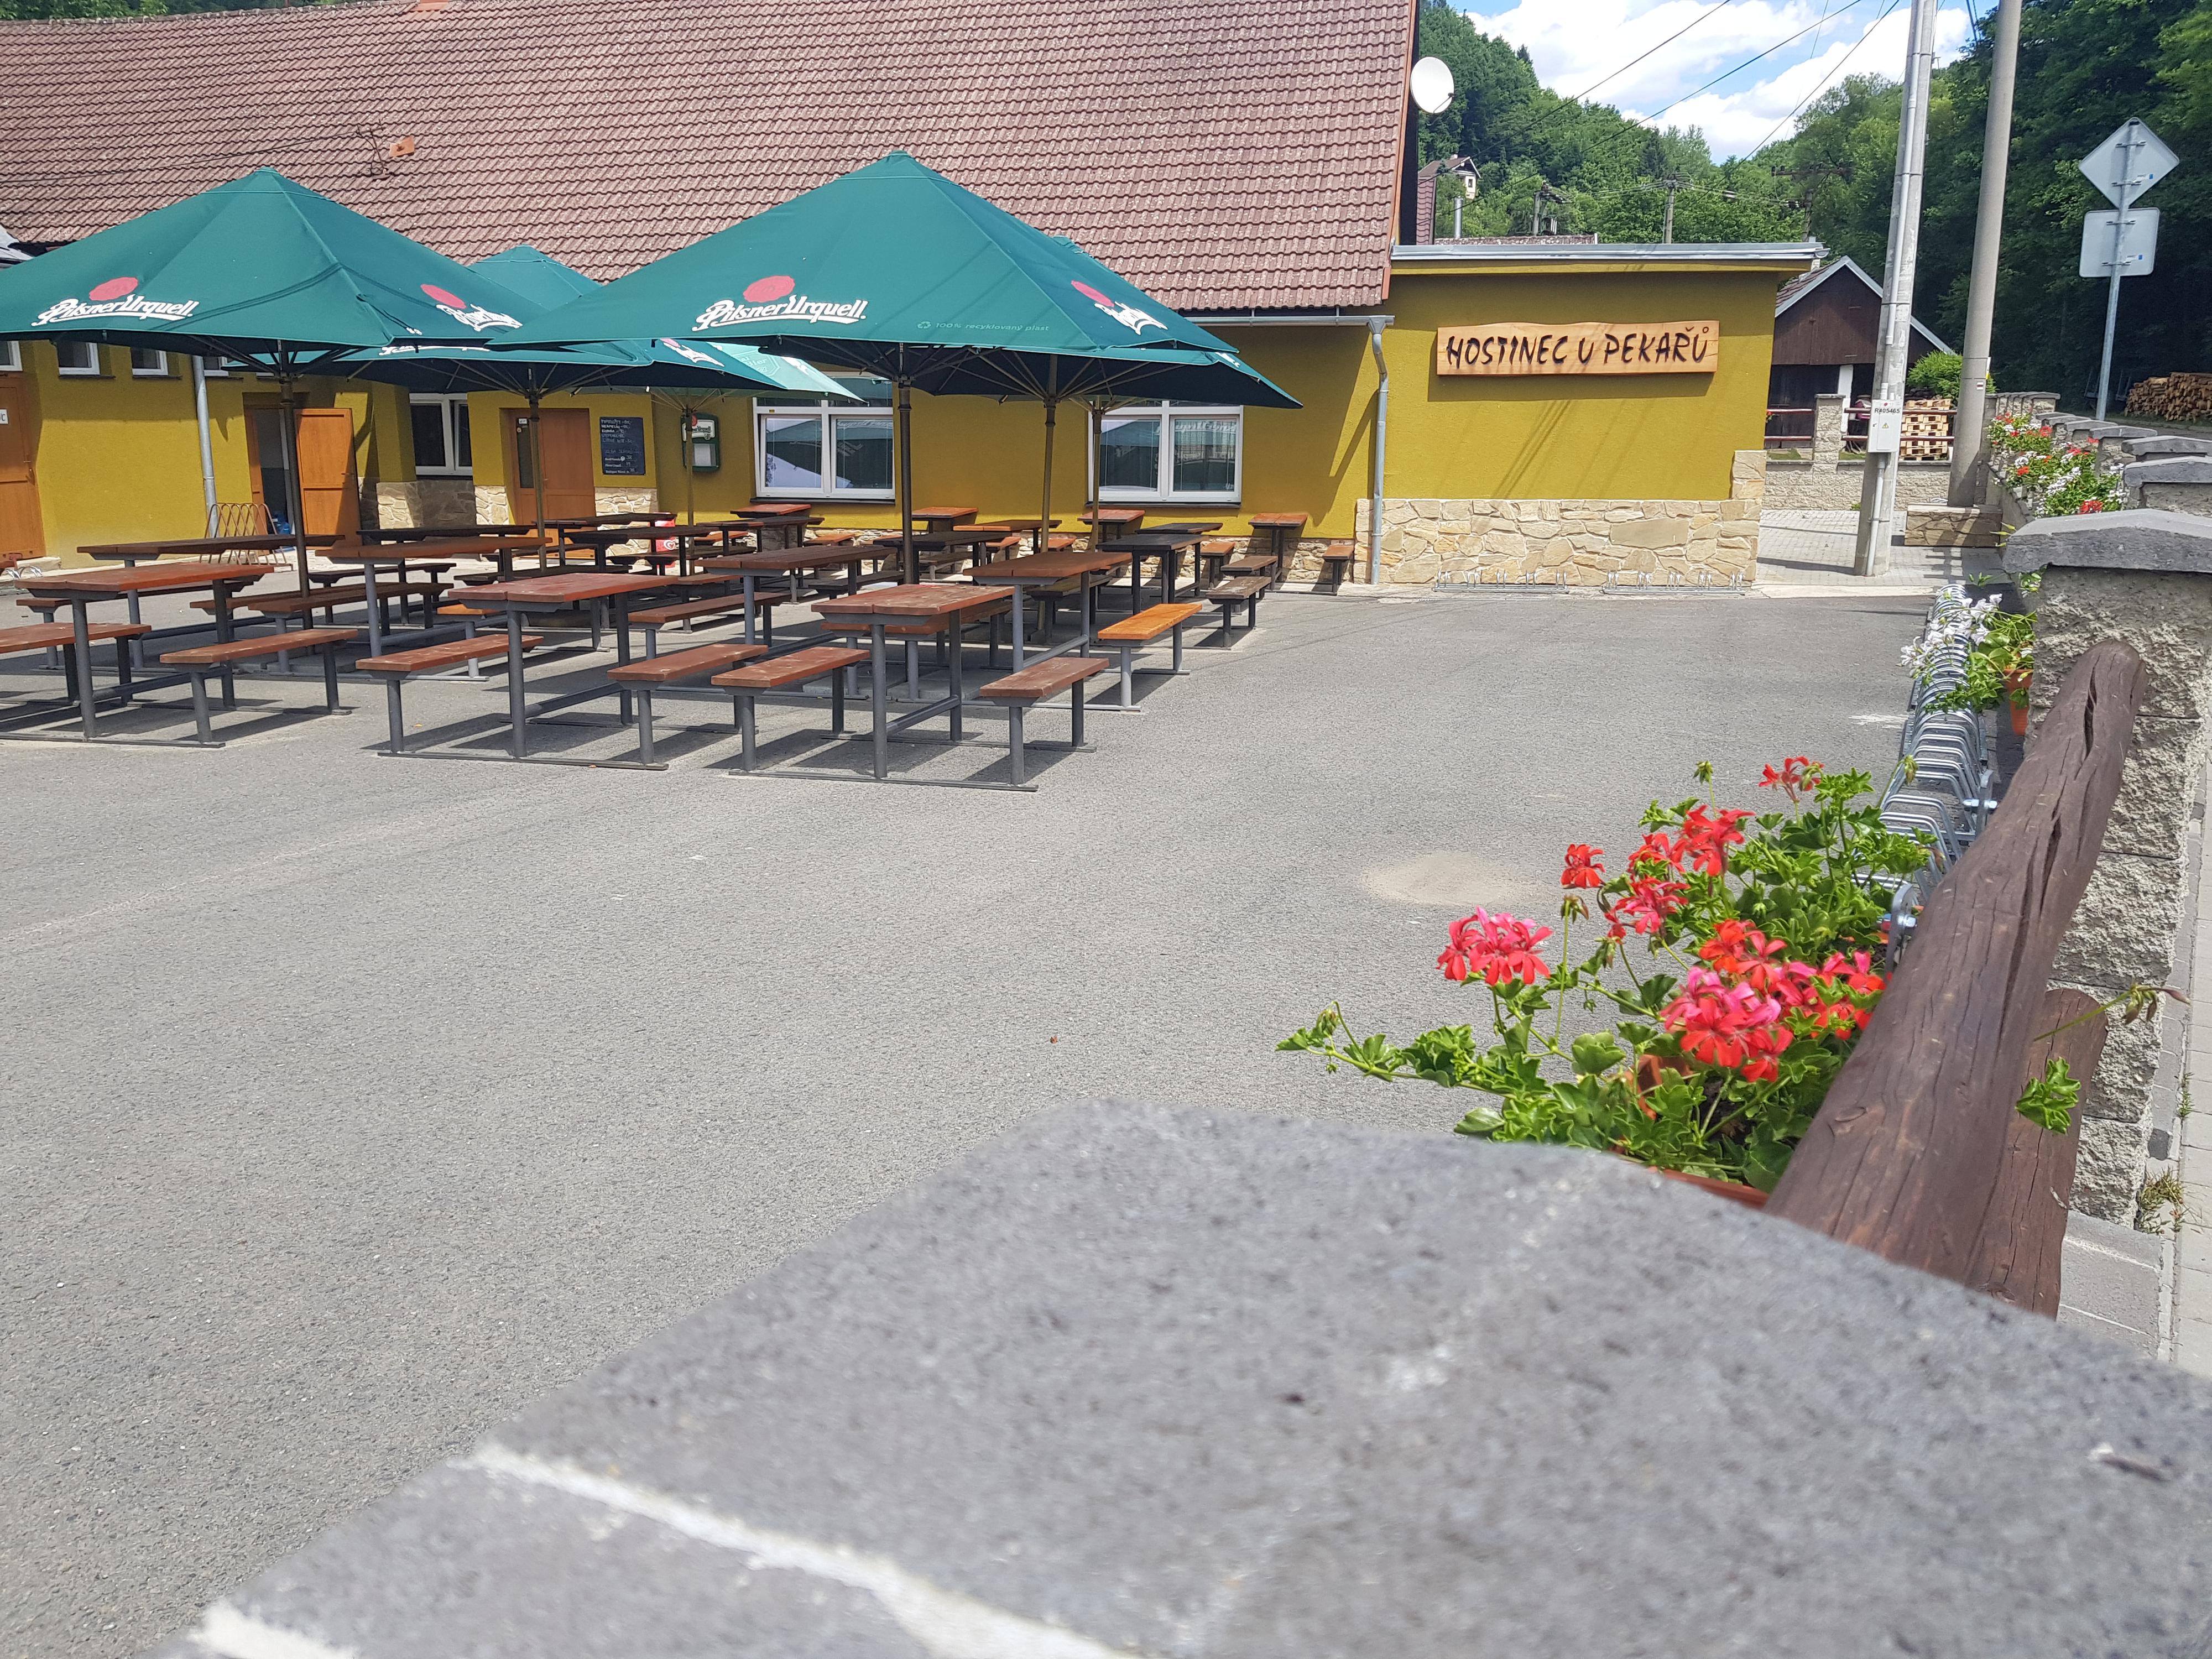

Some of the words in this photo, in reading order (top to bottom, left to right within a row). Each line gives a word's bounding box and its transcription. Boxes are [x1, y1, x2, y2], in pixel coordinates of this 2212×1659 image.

[31, 299, 127, 326] Pilsner
[692, 299, 789, 331] Pilsner
[1446, 334, 1568, 369] HOSTINEC
[1577, 337, 1594, 365] U
[1604, 326, 1709, 364] PEKAŘŮ
